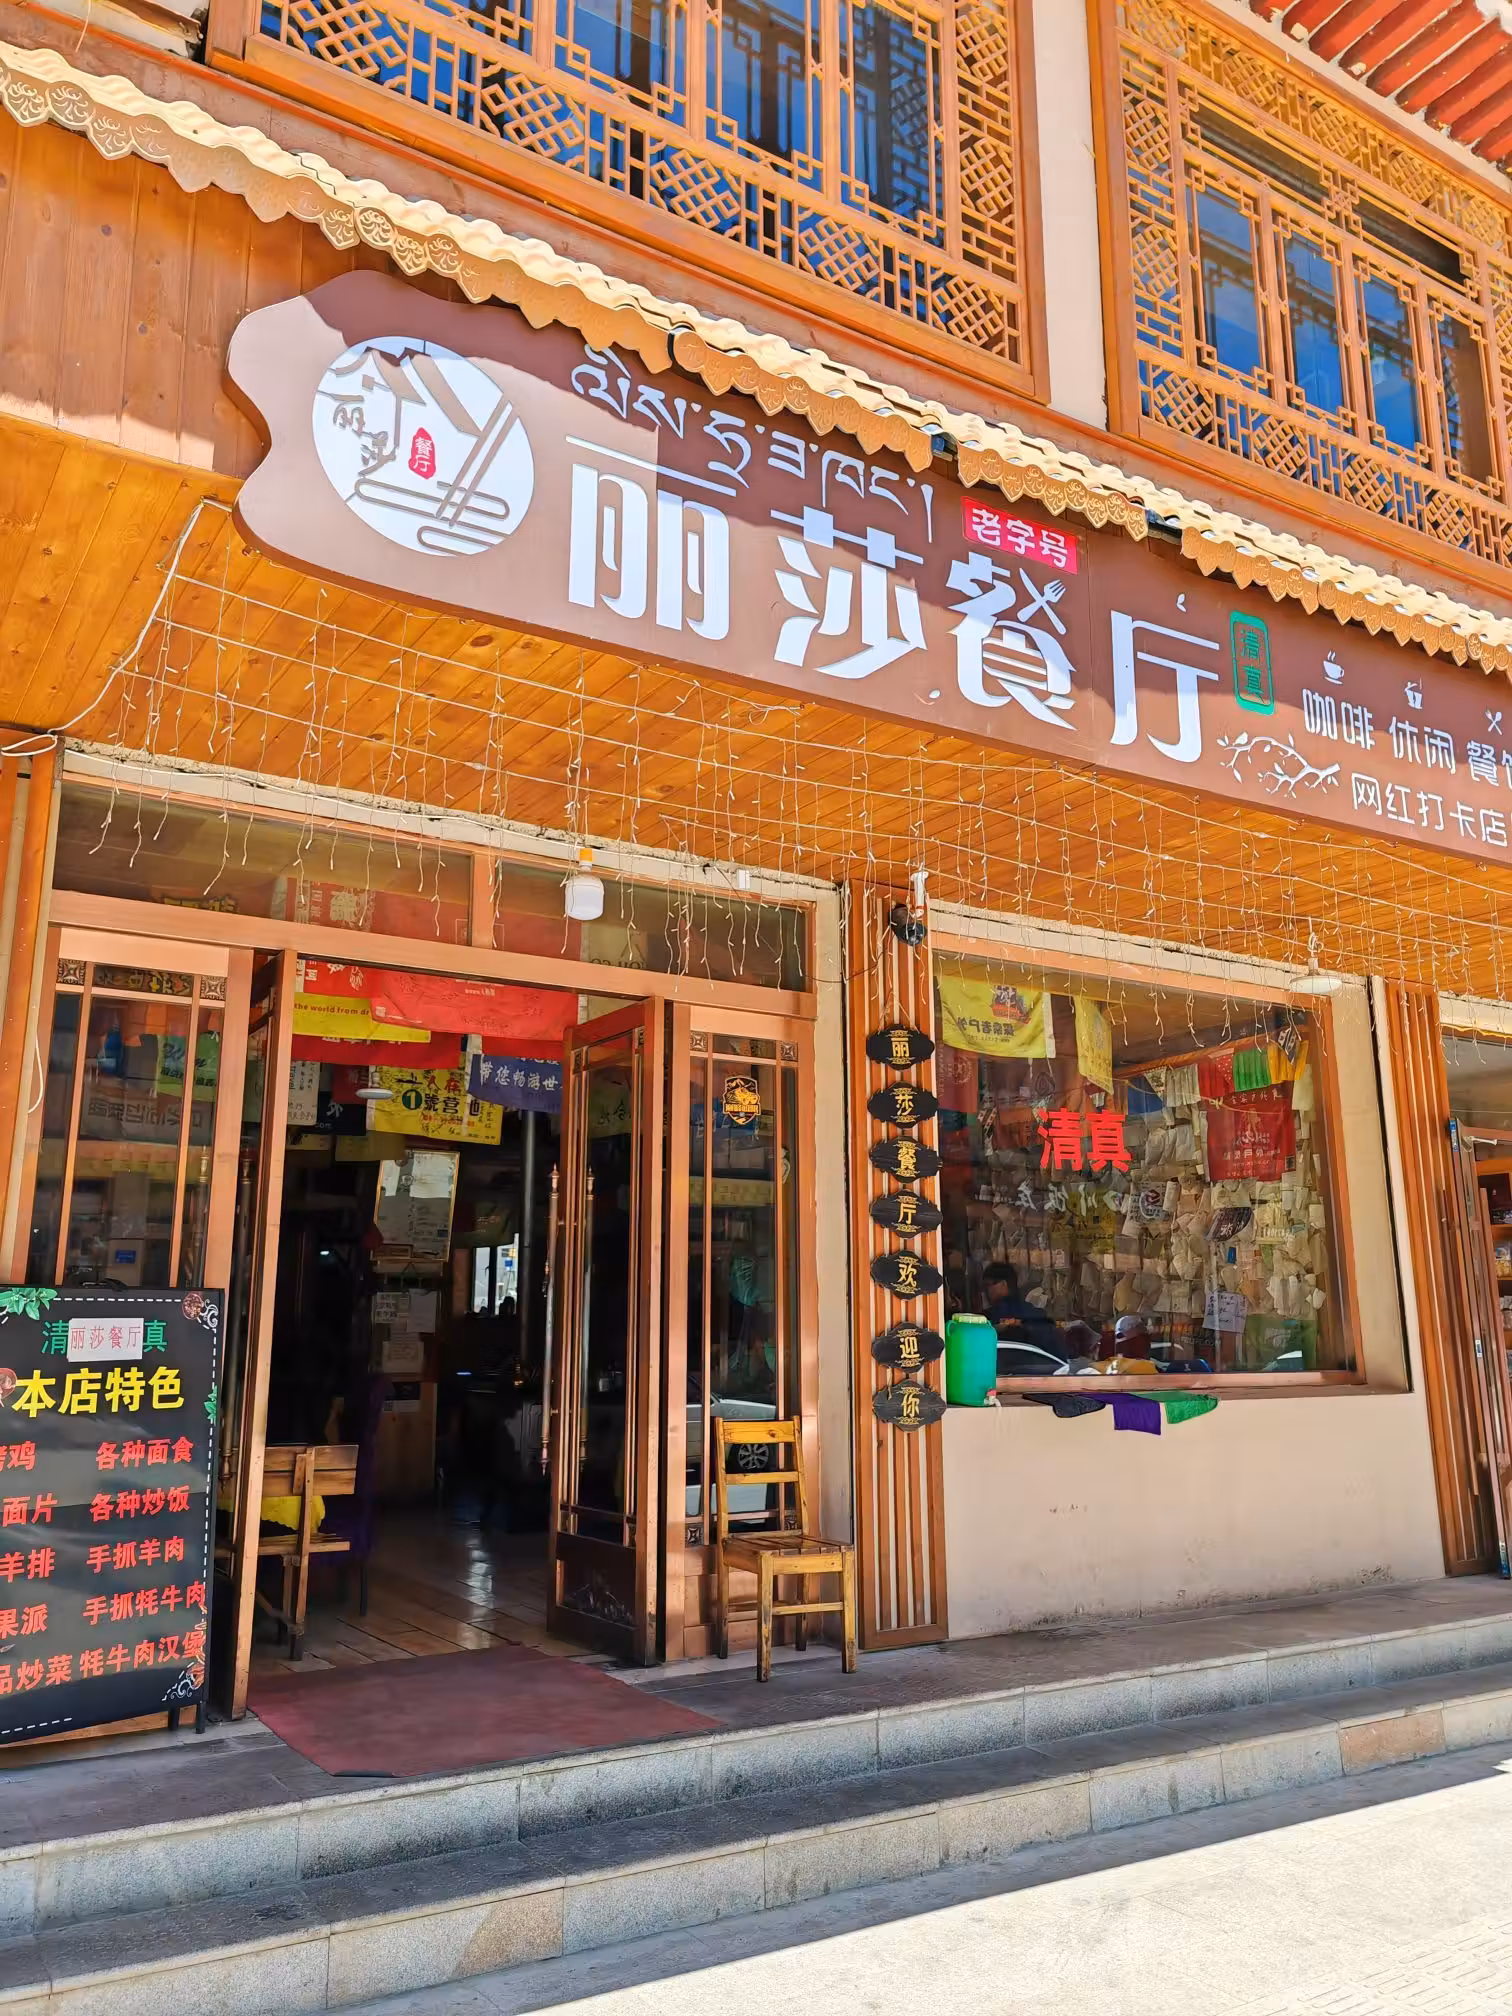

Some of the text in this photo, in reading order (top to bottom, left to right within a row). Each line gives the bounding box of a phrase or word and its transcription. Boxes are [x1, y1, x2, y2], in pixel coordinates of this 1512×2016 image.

[971, 508, 1069, 568] 老字号
[566, 435, 1220, 763] 丽莎餐厅
[1240, 629, 1266, 705] 清真
[1302, 688, 1376, 750] 咖啡
[1388, 715, 1457, 775] 休闲
[1351, 772, 1508, 848] 网红打卡店
[310, 1004, 335, 1014] world
[336, 1006, 358, 1014] from
[481, 1062, 563, 1092] 带您畅游世
[1037, 1107, 1132, 1173] 清真
[41, 1319, 168, 1355] 清 丽莎餐厅 真
[12, 1366, 185, 1419] 本店特色
[0, 1436, 194, 1473] 鸡 各种面食
[90, 1484, 190, 1523] 各种炒饭
[86, 1535, 185, 1573] 手抓羊肉
[83, 1580, 205, 1627] 手抓牦牛肉
[80, 1629, 205, 1679] 牦牛肉汉堡
